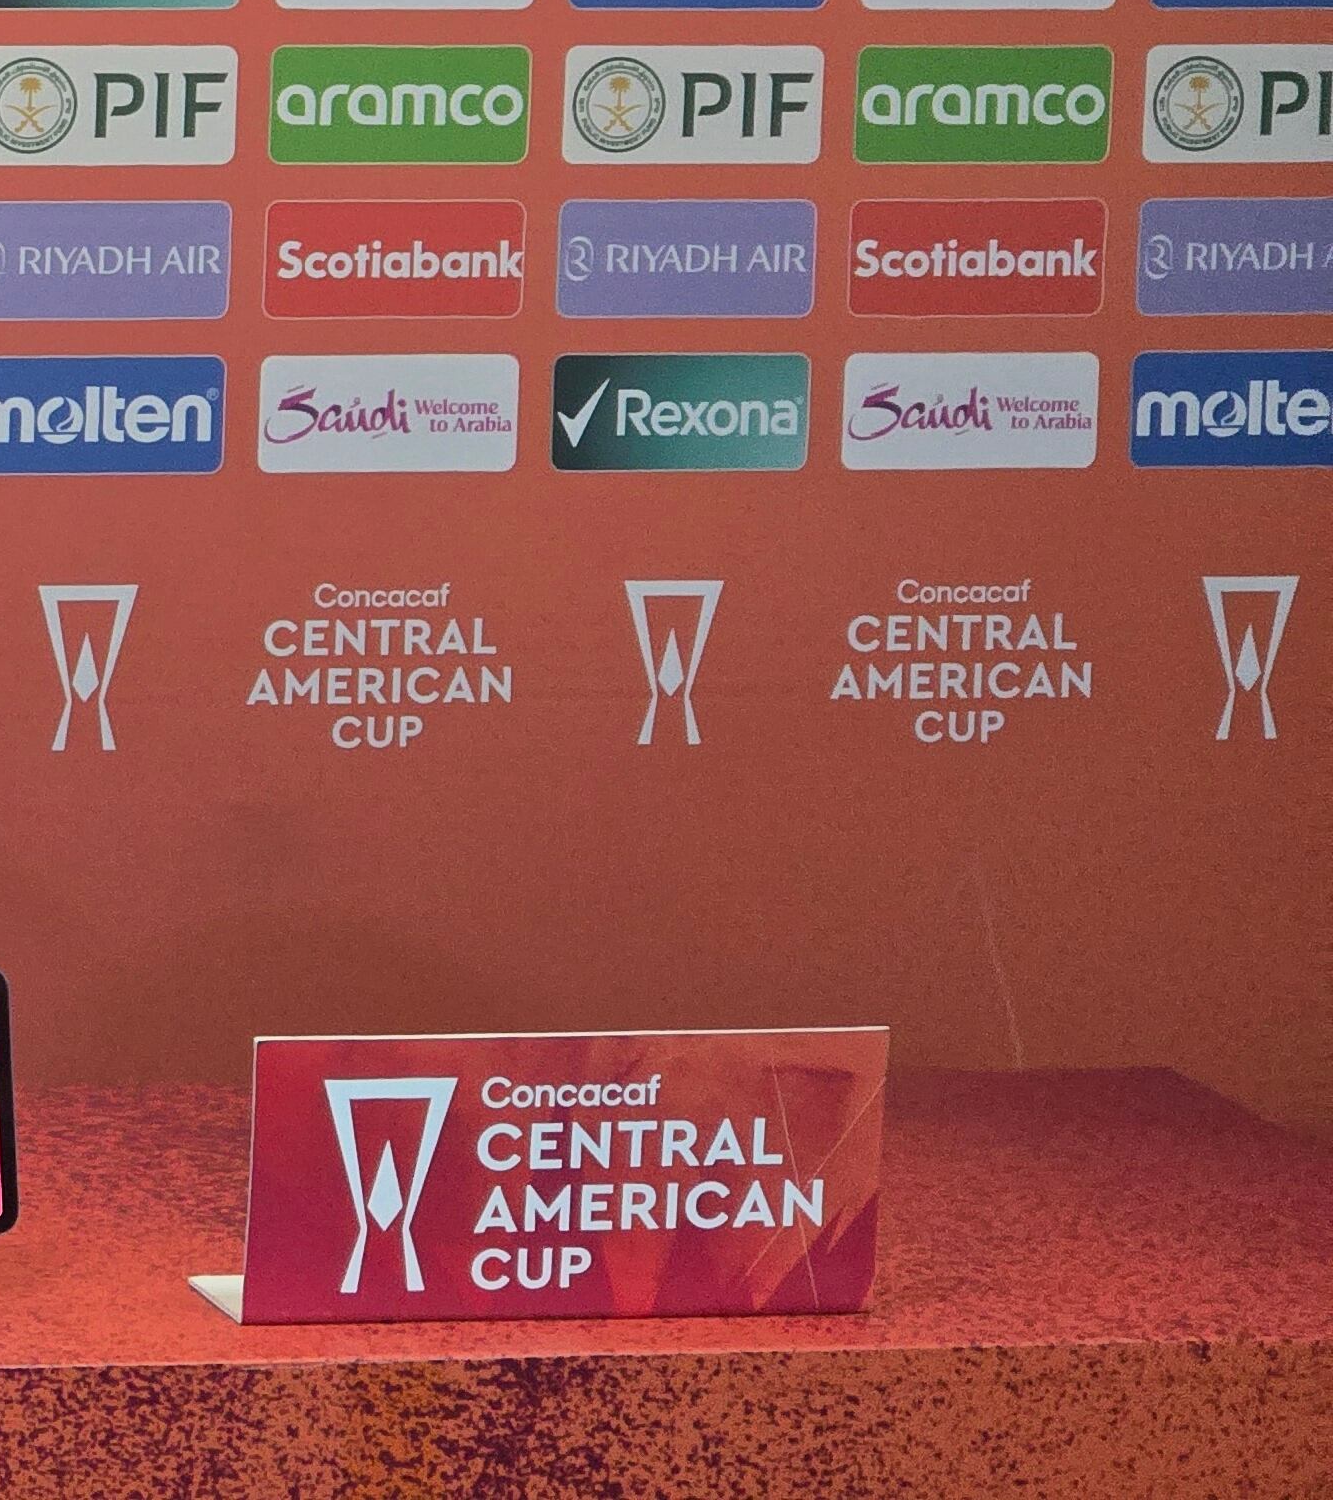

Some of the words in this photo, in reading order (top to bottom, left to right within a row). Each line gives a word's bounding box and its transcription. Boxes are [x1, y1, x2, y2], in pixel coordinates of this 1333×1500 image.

[95, 73, 228, 138] PIF
[276, 84, 523, 126] aramco
[685, 73, 814, 137] PIF
[862, 84, 1105, 125] aramco
[19, 246, 150, 274] RIYADH
[161, 246, 220, 274] AIR
[277, 240, 524, 279] Scotiabank
[607, 244, 737, 273] RIYADH
[747, 244, 806, 272] AIR
[856, 239, 1097, 277] Scotiabank
[616, 389, 798, 436] Rexona
[314, 583, 450, 608] Concacaf
[897, 579, 1030, 603] Concacaf
[264, 618, 496, 656] CENTRAL
[848, 613, 1077, 652] CENTRAL
[247, 666, 512, 705] AMERICAN
[830, 662, 1091, 699] AMERICAN
[332, 716, 422, 748] CUP
[915, 710, 1004, 742] CUP
[482, 1074, 661, 1108] Concacaf
[477, 1118, 783, 1171] CENTRAL
[474, 1179, 823, 1233] AMERICAN
[472, 1247, 591, 1290] CUP
